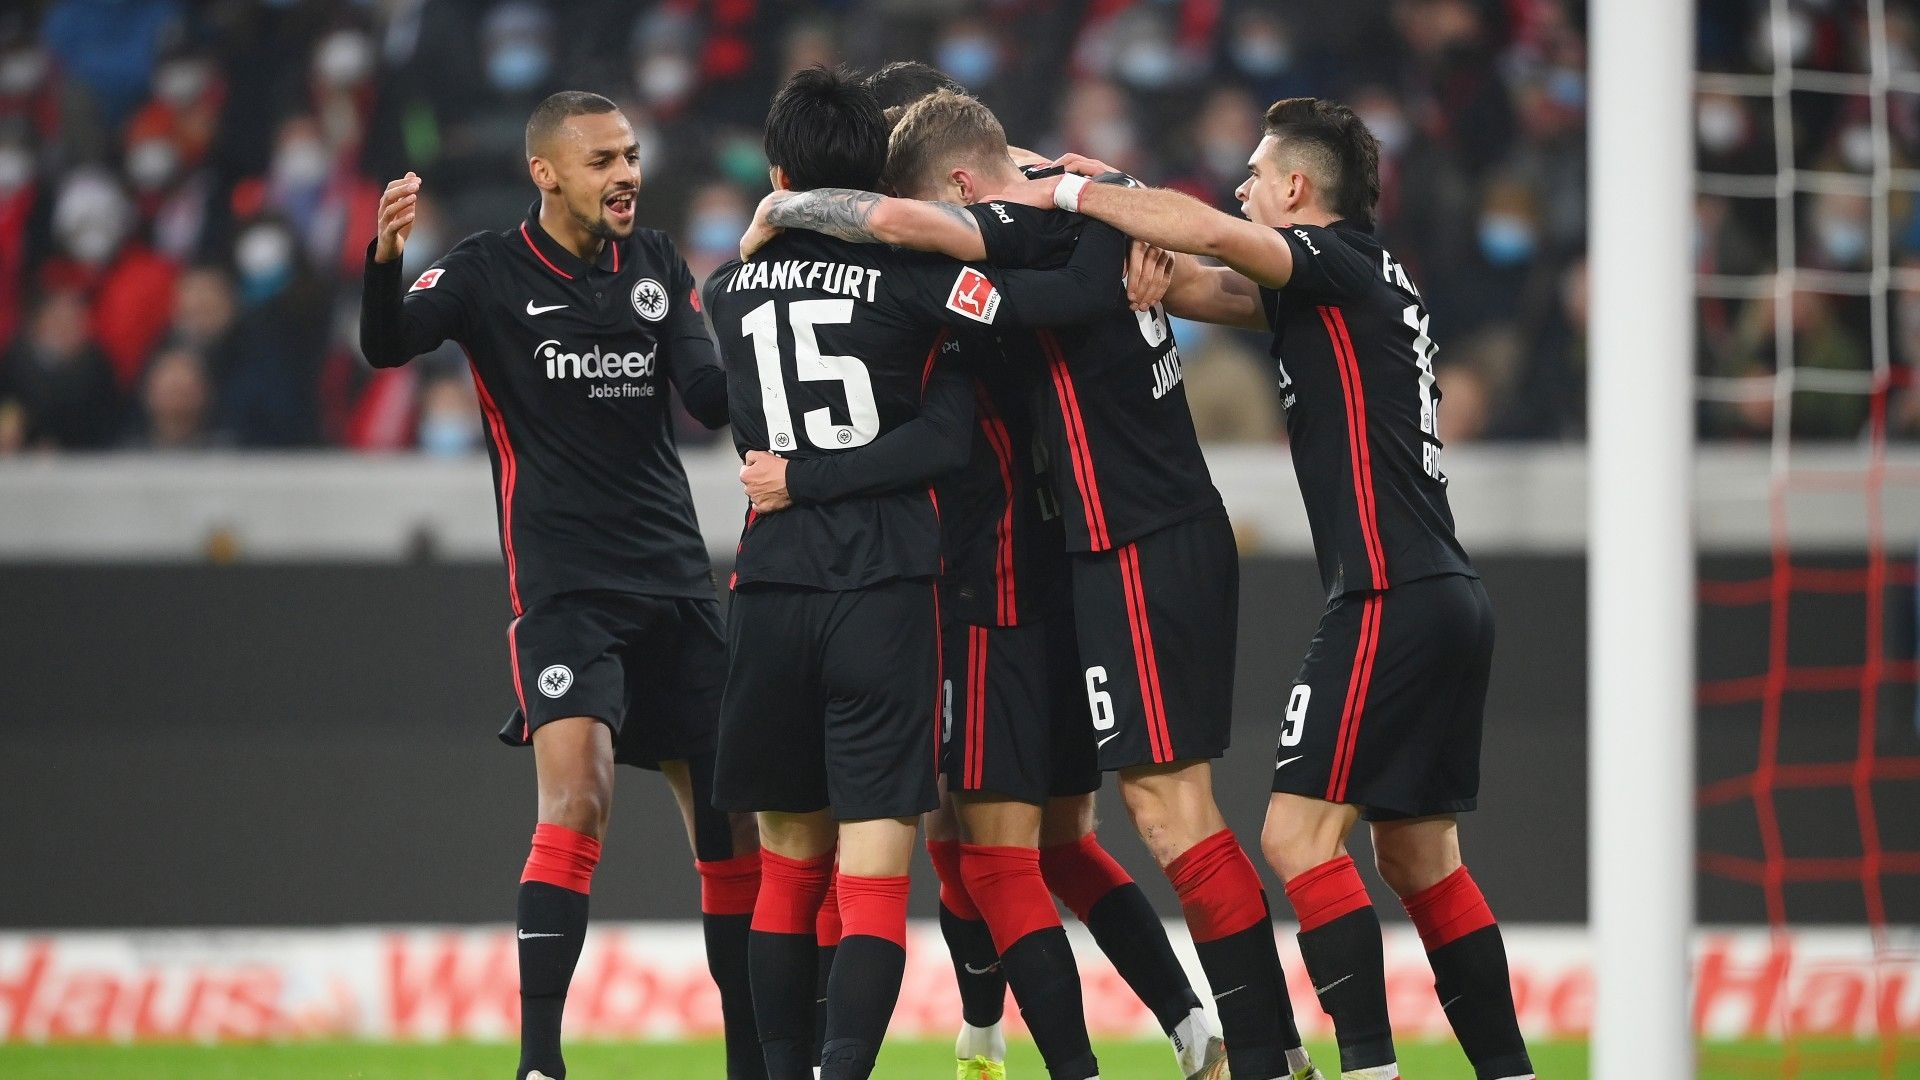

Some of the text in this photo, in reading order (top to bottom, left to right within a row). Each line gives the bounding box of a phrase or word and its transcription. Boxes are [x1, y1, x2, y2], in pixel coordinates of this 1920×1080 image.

[536, 340, 658, 380] indeed
[587, 382, 655, 399] Jobs finde
[741, 298, 880, 451] 15
[1085, 665, 1115, 731] 6
[1279, 684, 1312, 748] 9
